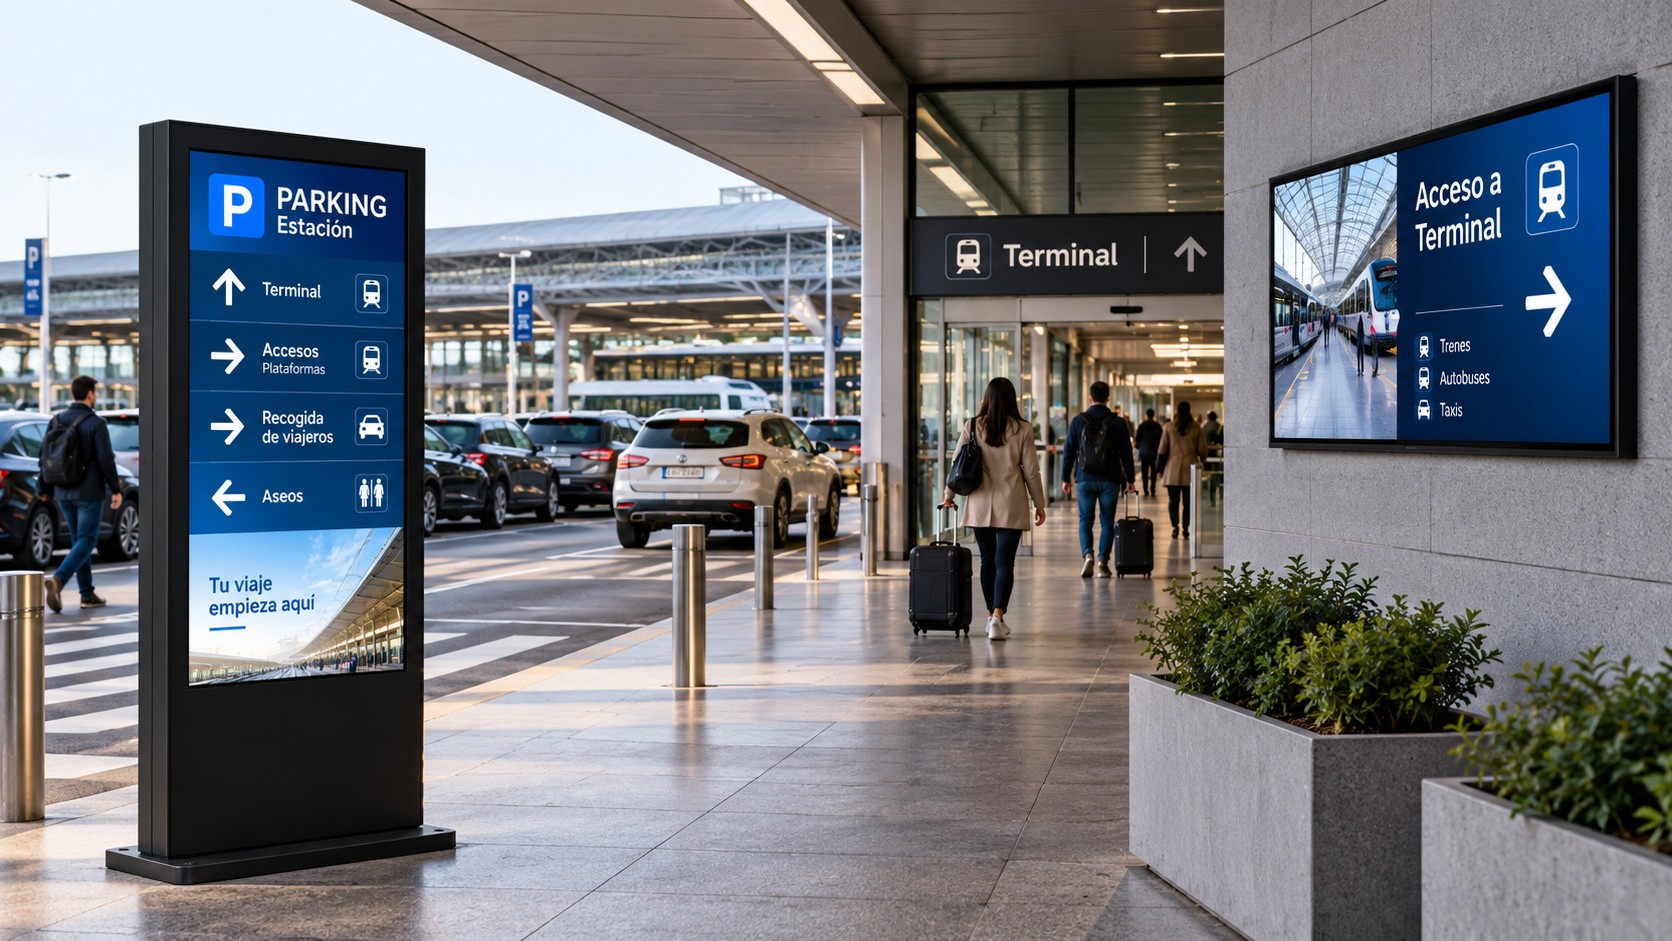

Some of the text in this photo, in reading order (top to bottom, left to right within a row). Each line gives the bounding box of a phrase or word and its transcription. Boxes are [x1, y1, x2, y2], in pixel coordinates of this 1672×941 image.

[1415, 171, 1502, 212] Acceso a
[223, 184, 253, 228] P
[277, 186, 387, 218] PARKING
[277, 216, 353, 239] Estación
[1415, 207, 1502, 252] Terminal
[28, 246, 39, 269] P
[1002, 242, 1118, 267] Terminal
[262, 281, 322, 299] Terminal
[517, 290, 529, 308] P
[262, 342, 319, 358] Accesos
[1439, 338, 1471, 353] Trenes
[262, 362, 326, 375] Plataformas
[1439, 369, 1491, 386] Autobuses
[262, 410, 324, 428] Recogida
[1439, 402, 1463, 418] Taxis
[262, 429, 334, 447] de viajeros
[261, 489, 304, 504] Aseos
[208, 575, 273, 596] Tu viaje
[208, 594, 316, 619] empieza aquí
